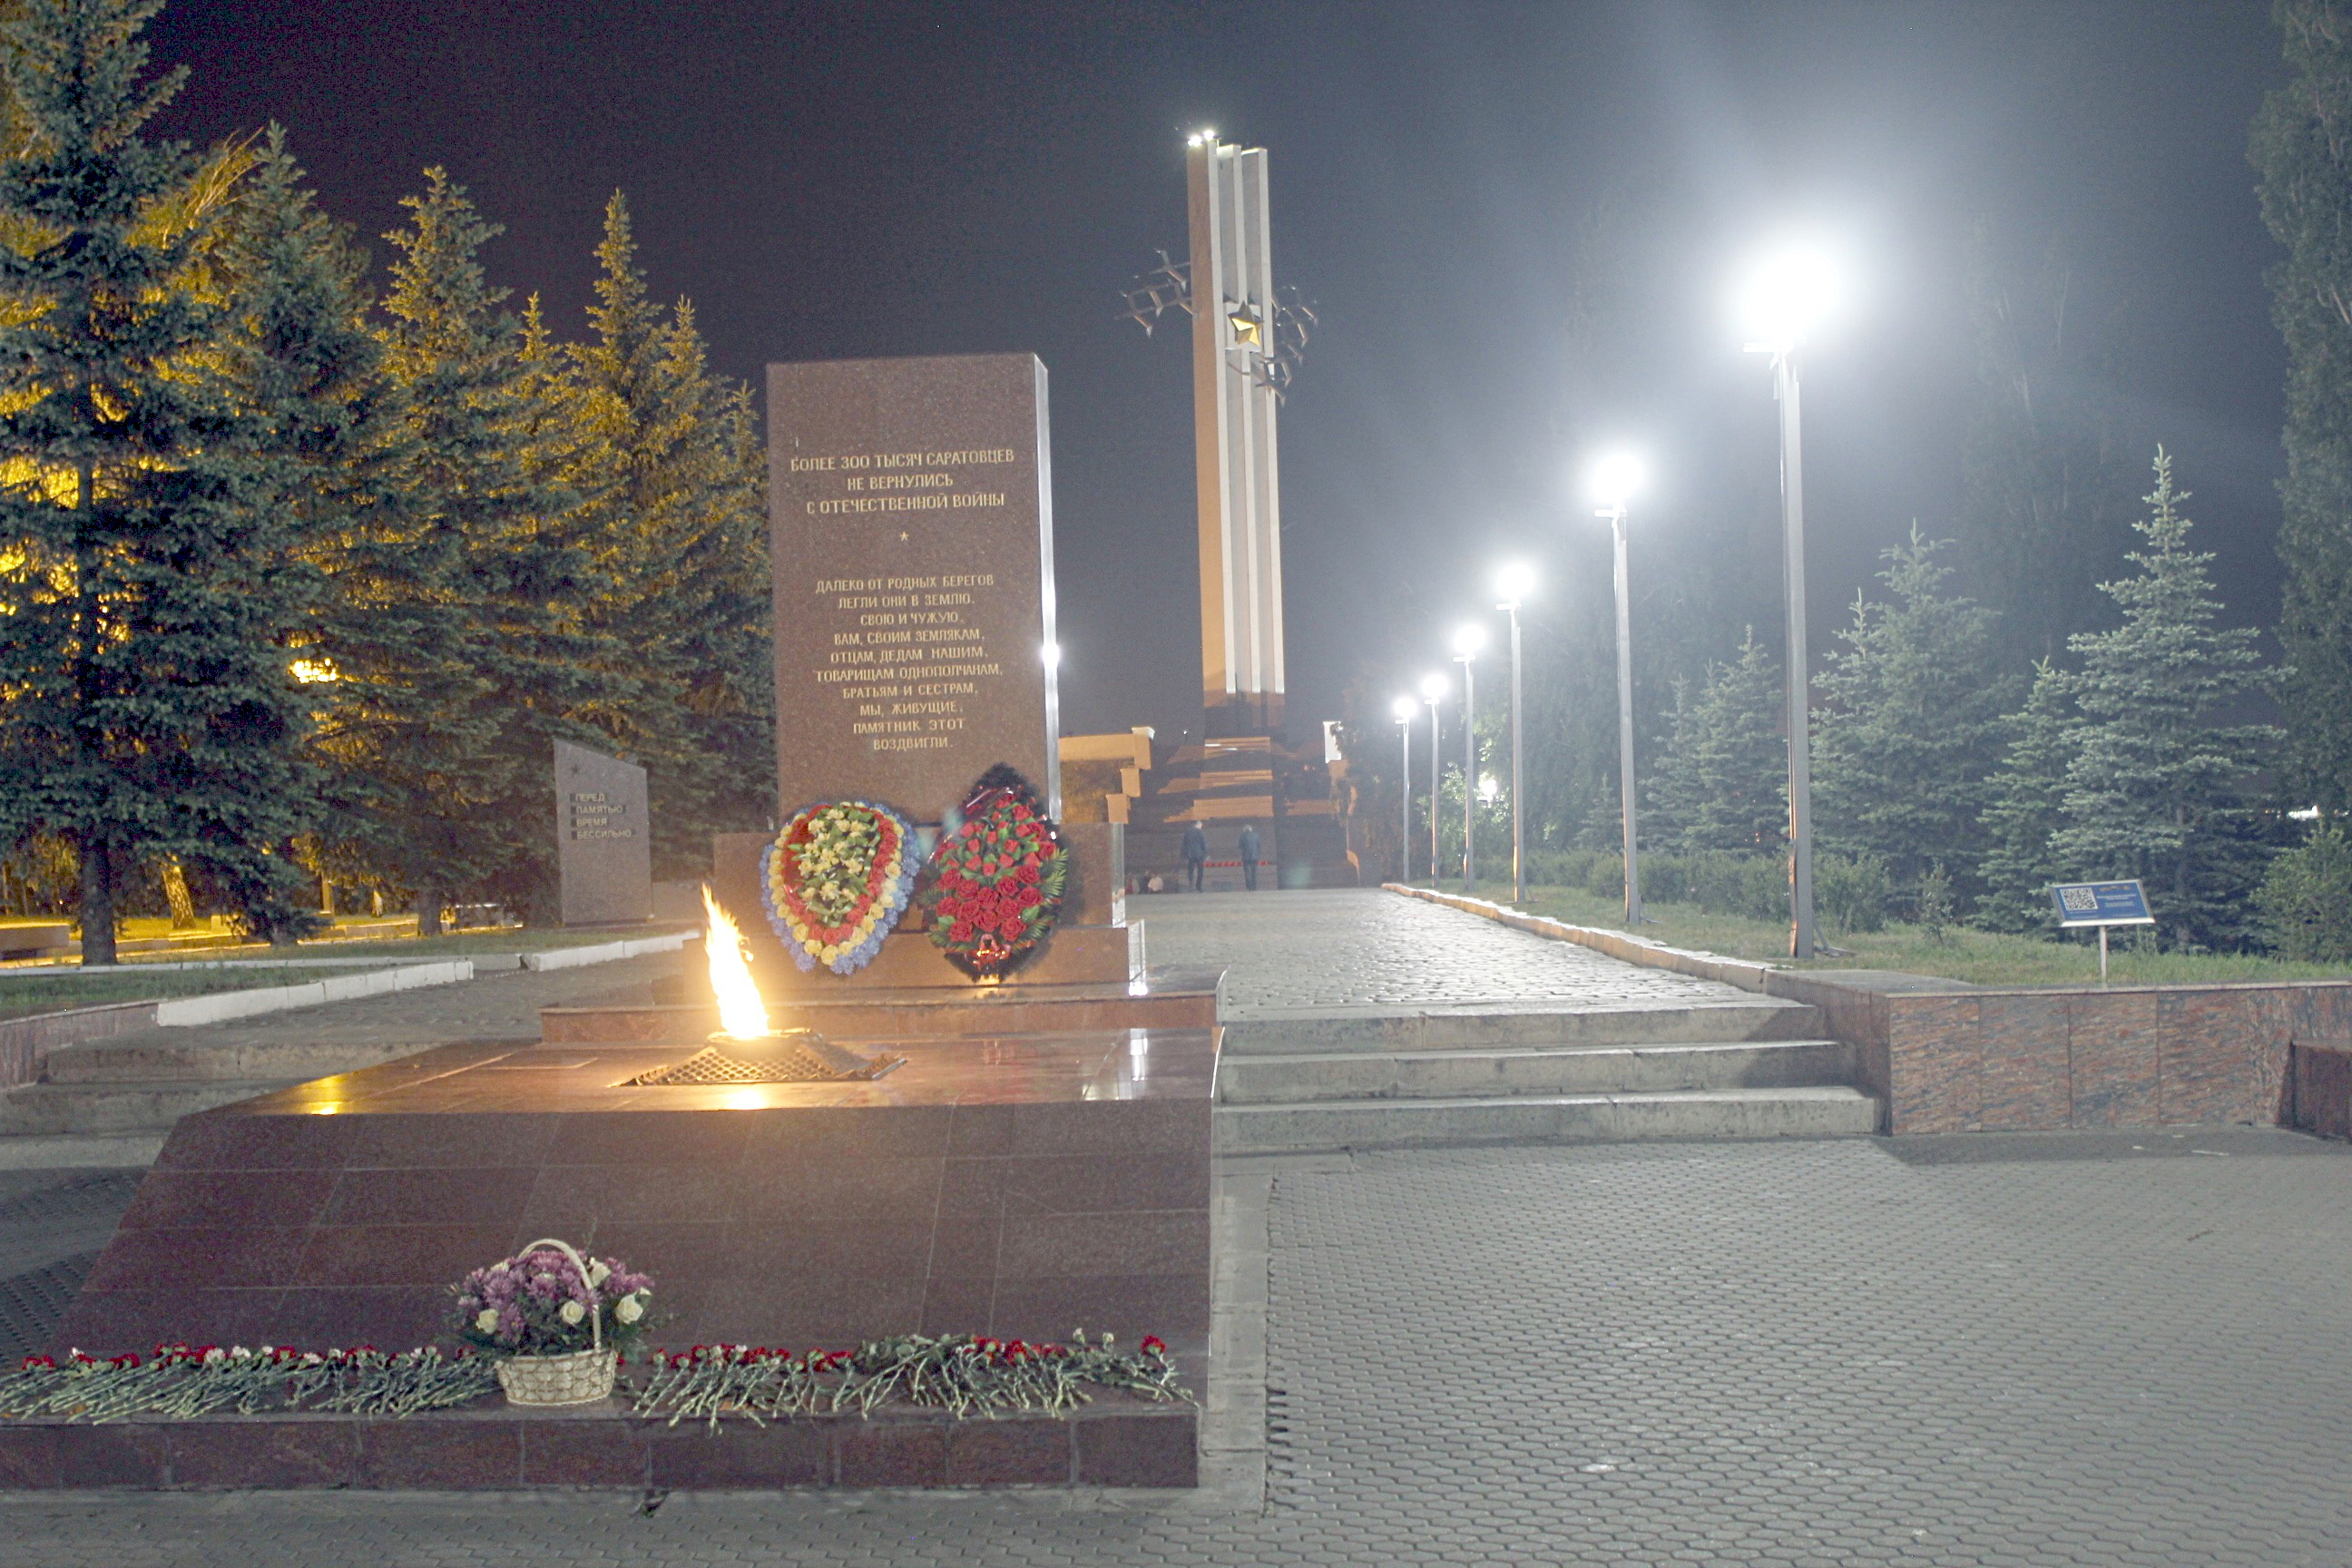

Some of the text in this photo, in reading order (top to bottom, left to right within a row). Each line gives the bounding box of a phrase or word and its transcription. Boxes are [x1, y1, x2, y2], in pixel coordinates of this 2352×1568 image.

[790, 457, 836, 472] БОЛЕЕ
[874, 453, 922, 468] ТЫСЯЧ
[926, 449, 1014, 466] САРАТОВЦЕВ
[848, 473, 953, 491] НЕ ВЕРНУЛИСЬ
[807, 491, 1004, 514] С ОТЕЧЕСТВЕННОЙ ВОЙНЫ
[816, 573, 995, 593] ДАЛЕКО ОТ РОДНЫХ БЕРЕГОВ
[838, 596, 877, 609] ЛЕГЛИ
[882, 595, 906, 607] ОНИ
[911, 594, 919, 606] В
[860, 612, 895, 626] СВОЮ
[898, 612, 907, 624] И
[867, 631, 911, 644] СВОИМ
[879, 648, 923, 663] ДЕДАМ
[816, 663, 1003, 682] ТОВАРИЩАМ ОДНОПОЛЧАНАМ,
[843, 686, 897, 700] БРАТЬЯМ
[904, 685, 913, 696] И
[859, 704, 885, 718] МЫ,
[853, 718, 965, 735] ПАМЯТНИК ЭТОТ
[575, 793, 606, 803] ПЕРЕД
[576, 805, 623, 815] ПАМЯТЬЮ
[576, 818, 608, 828] ВРЕМЯ
